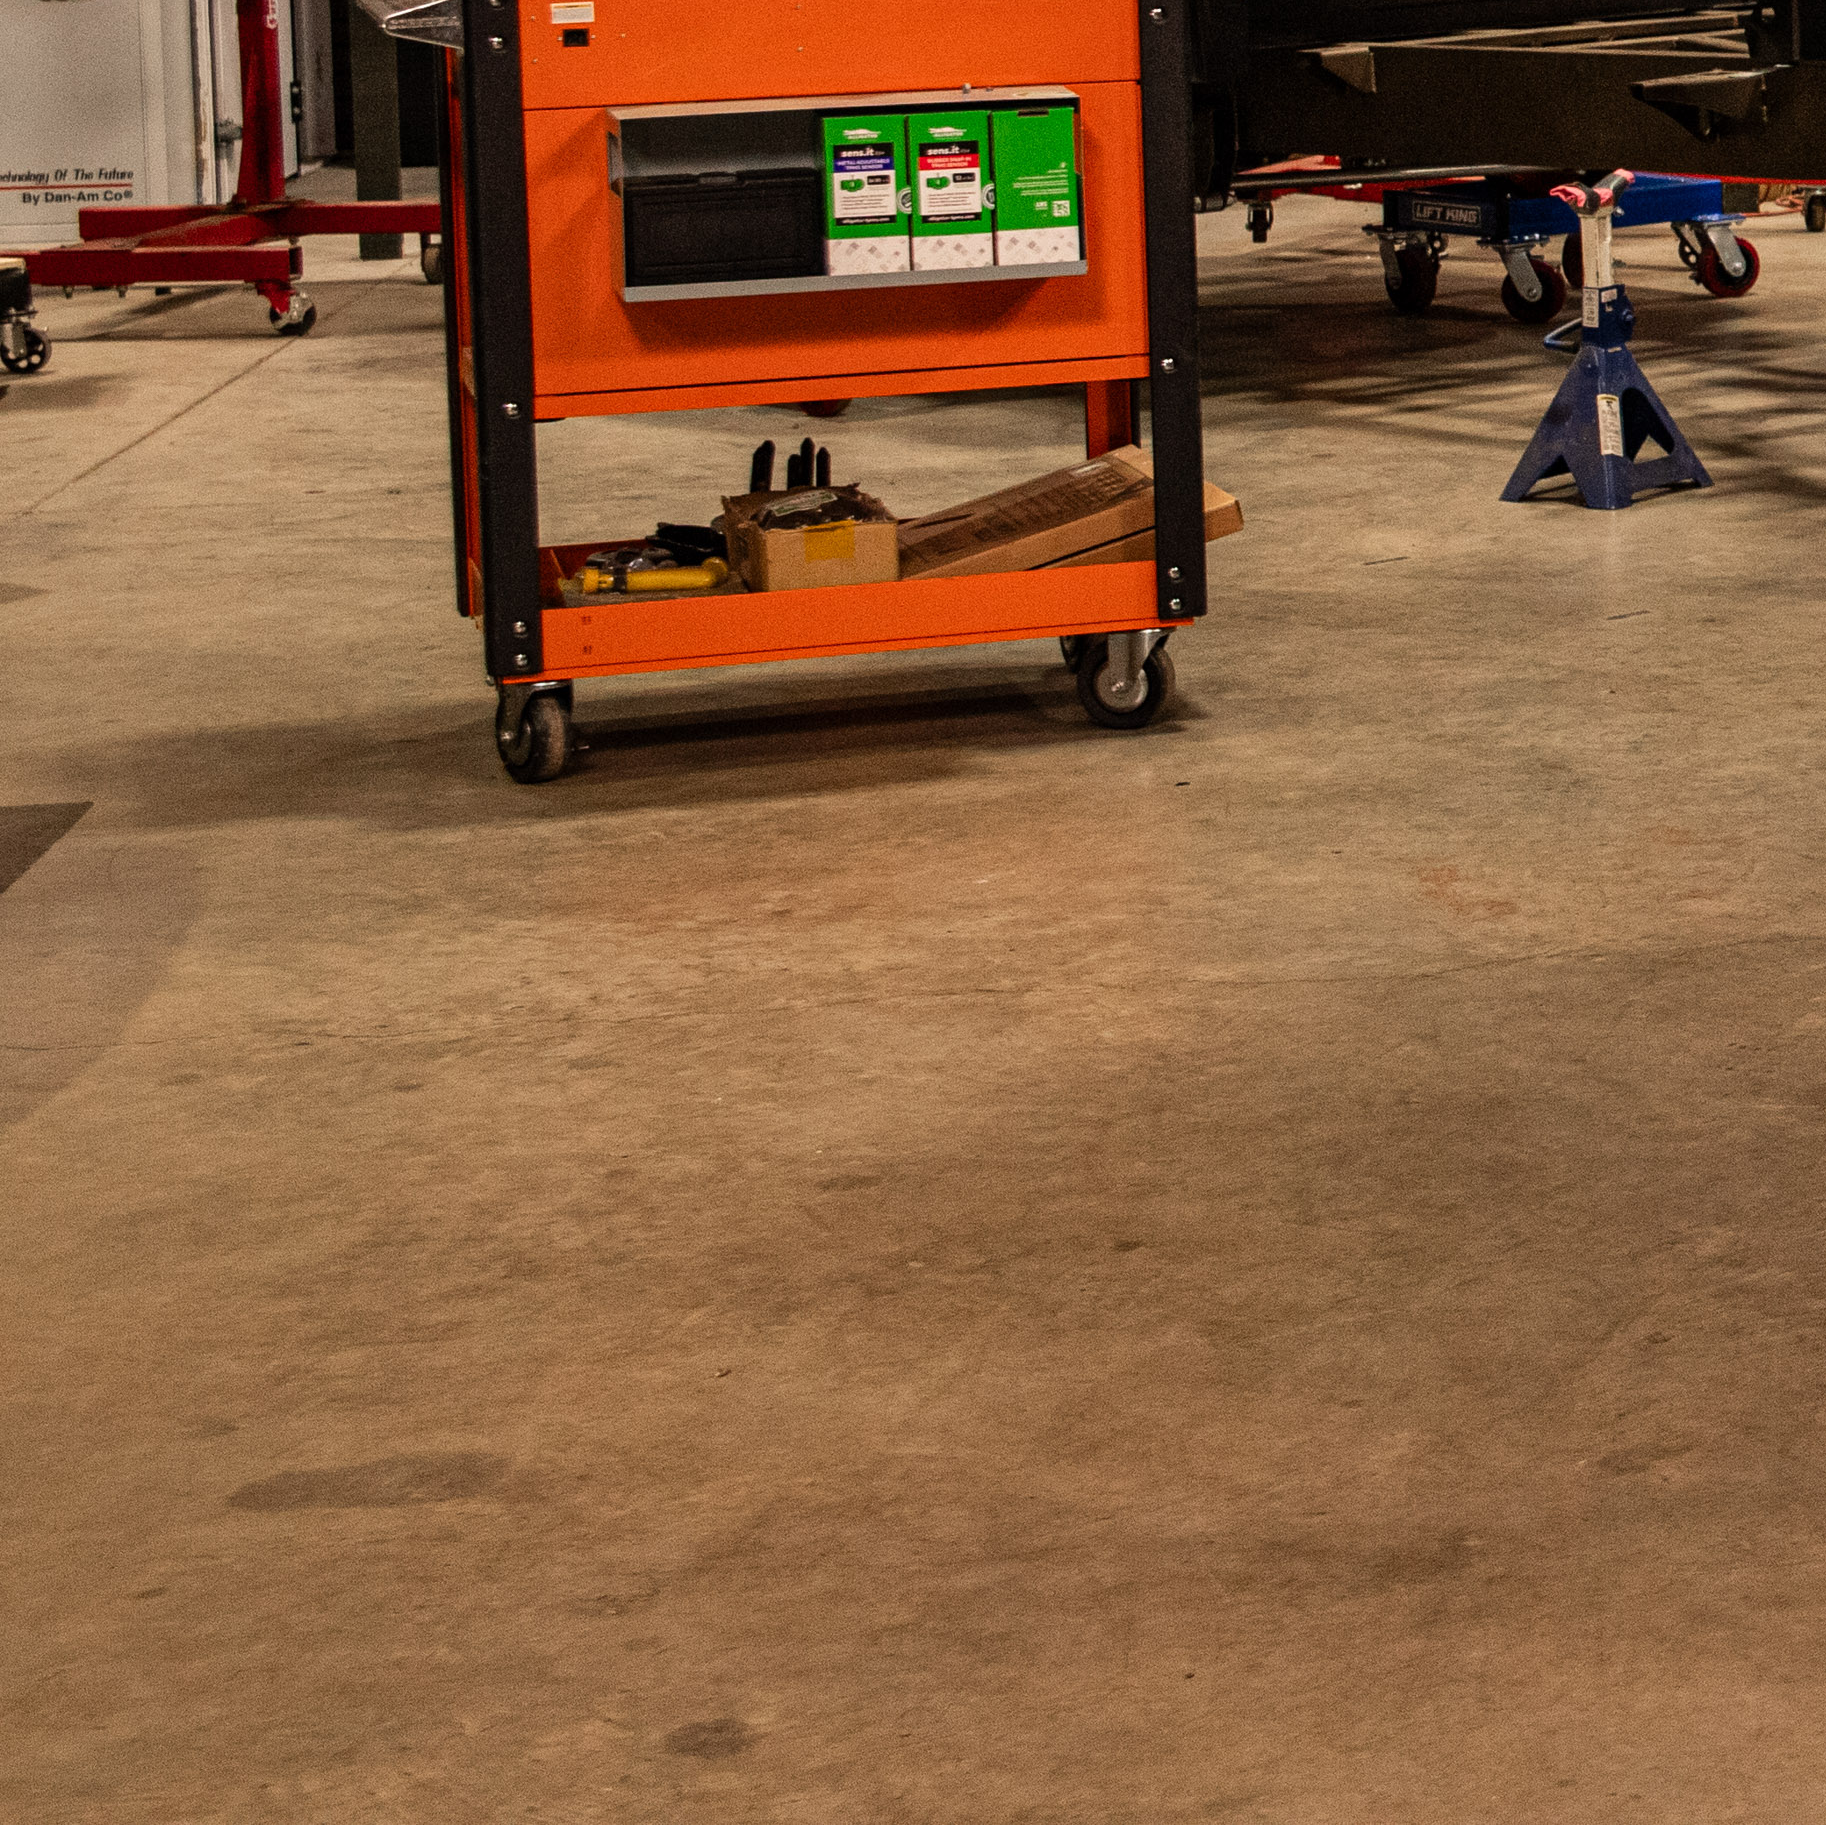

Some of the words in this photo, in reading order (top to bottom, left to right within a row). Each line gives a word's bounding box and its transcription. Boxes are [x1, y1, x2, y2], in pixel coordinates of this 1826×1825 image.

[22, 191, 40, 206] By
[44, 190, 100, 204] Dan-Am
[1416, 204, 1443, 220] LIFT
[1446, 208, 1478, 224] KING
